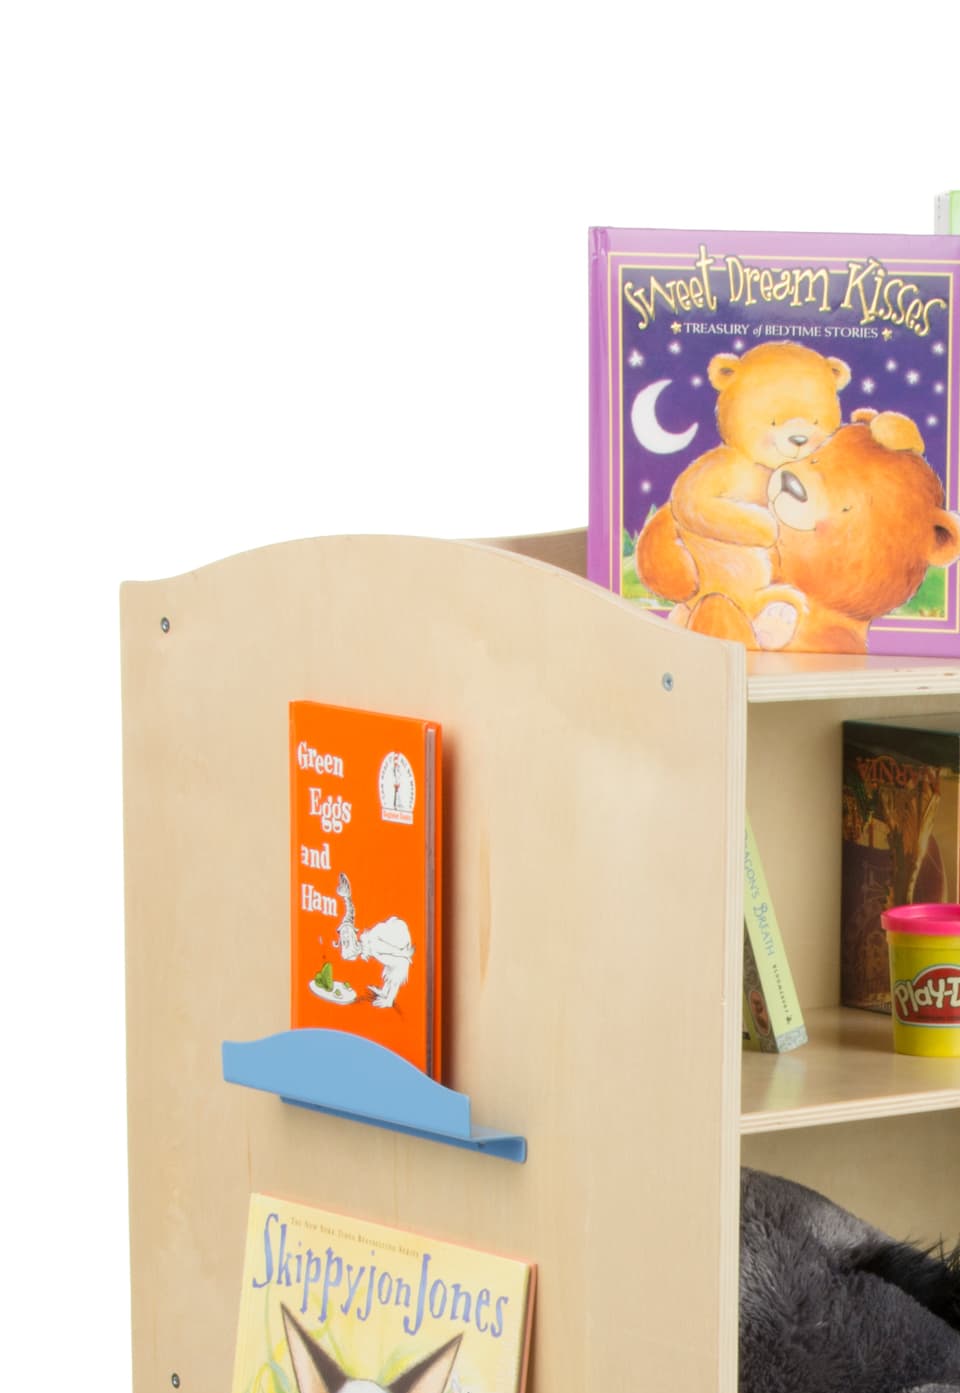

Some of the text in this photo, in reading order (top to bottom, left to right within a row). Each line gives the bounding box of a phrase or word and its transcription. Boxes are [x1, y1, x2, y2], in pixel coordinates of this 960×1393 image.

[624, 244, 947, 337] Sweet Dream Kisses
[683, 322, 878, 340] TREASURY of BEDTIME STORIES
[297, 741, 344, 778] Green
[309, 787, 353, 833] Eggs
[300, 843, 331, 871] and
[301, 883, 338, 918] Ham
[753, 902, 777, 957] BREATH
